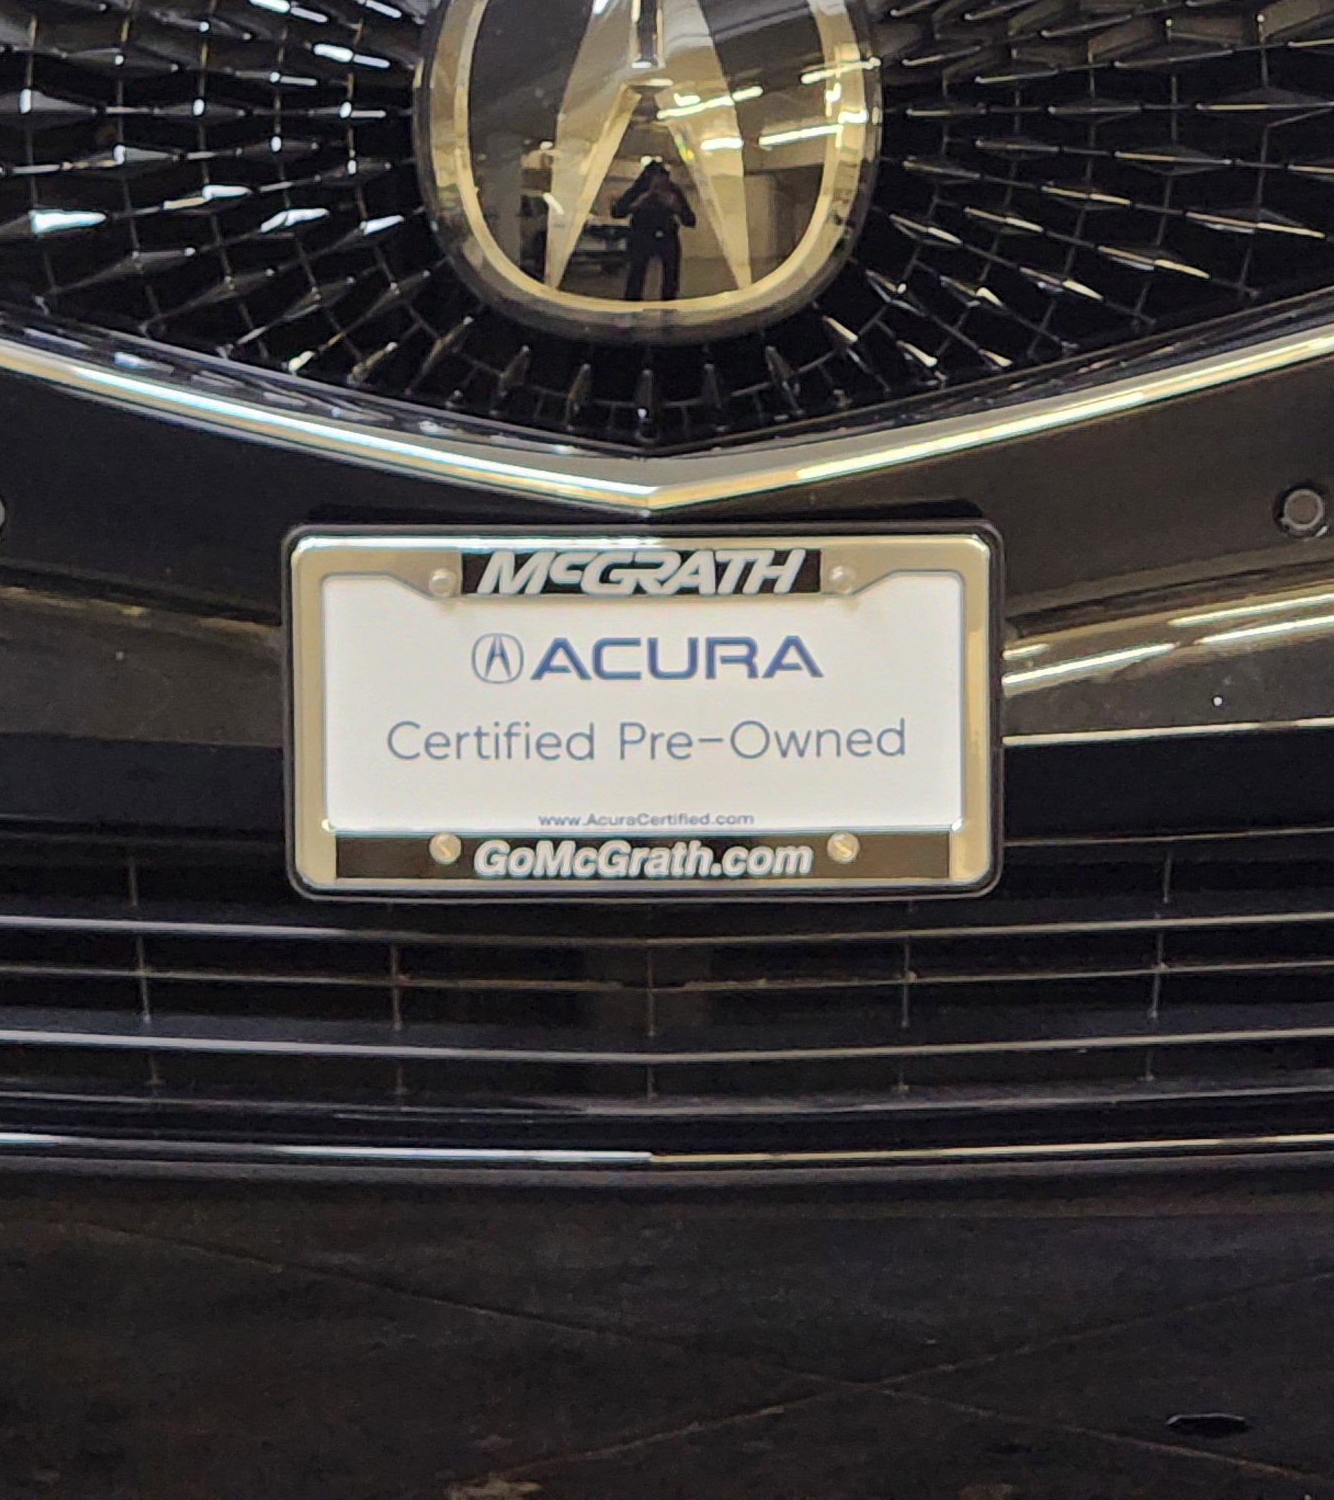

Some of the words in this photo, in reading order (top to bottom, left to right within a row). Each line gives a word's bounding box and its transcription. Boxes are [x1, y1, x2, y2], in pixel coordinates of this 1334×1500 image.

[530, 635, 824, 681] ACURA
[387, 720, 595, 761] Certified
[619, 718, 907, 761] Pre-Owned
[538, 812, 755, 828] www.AcuraCertified.com
[474, 839, 814, 879] GoMcGrath.com
